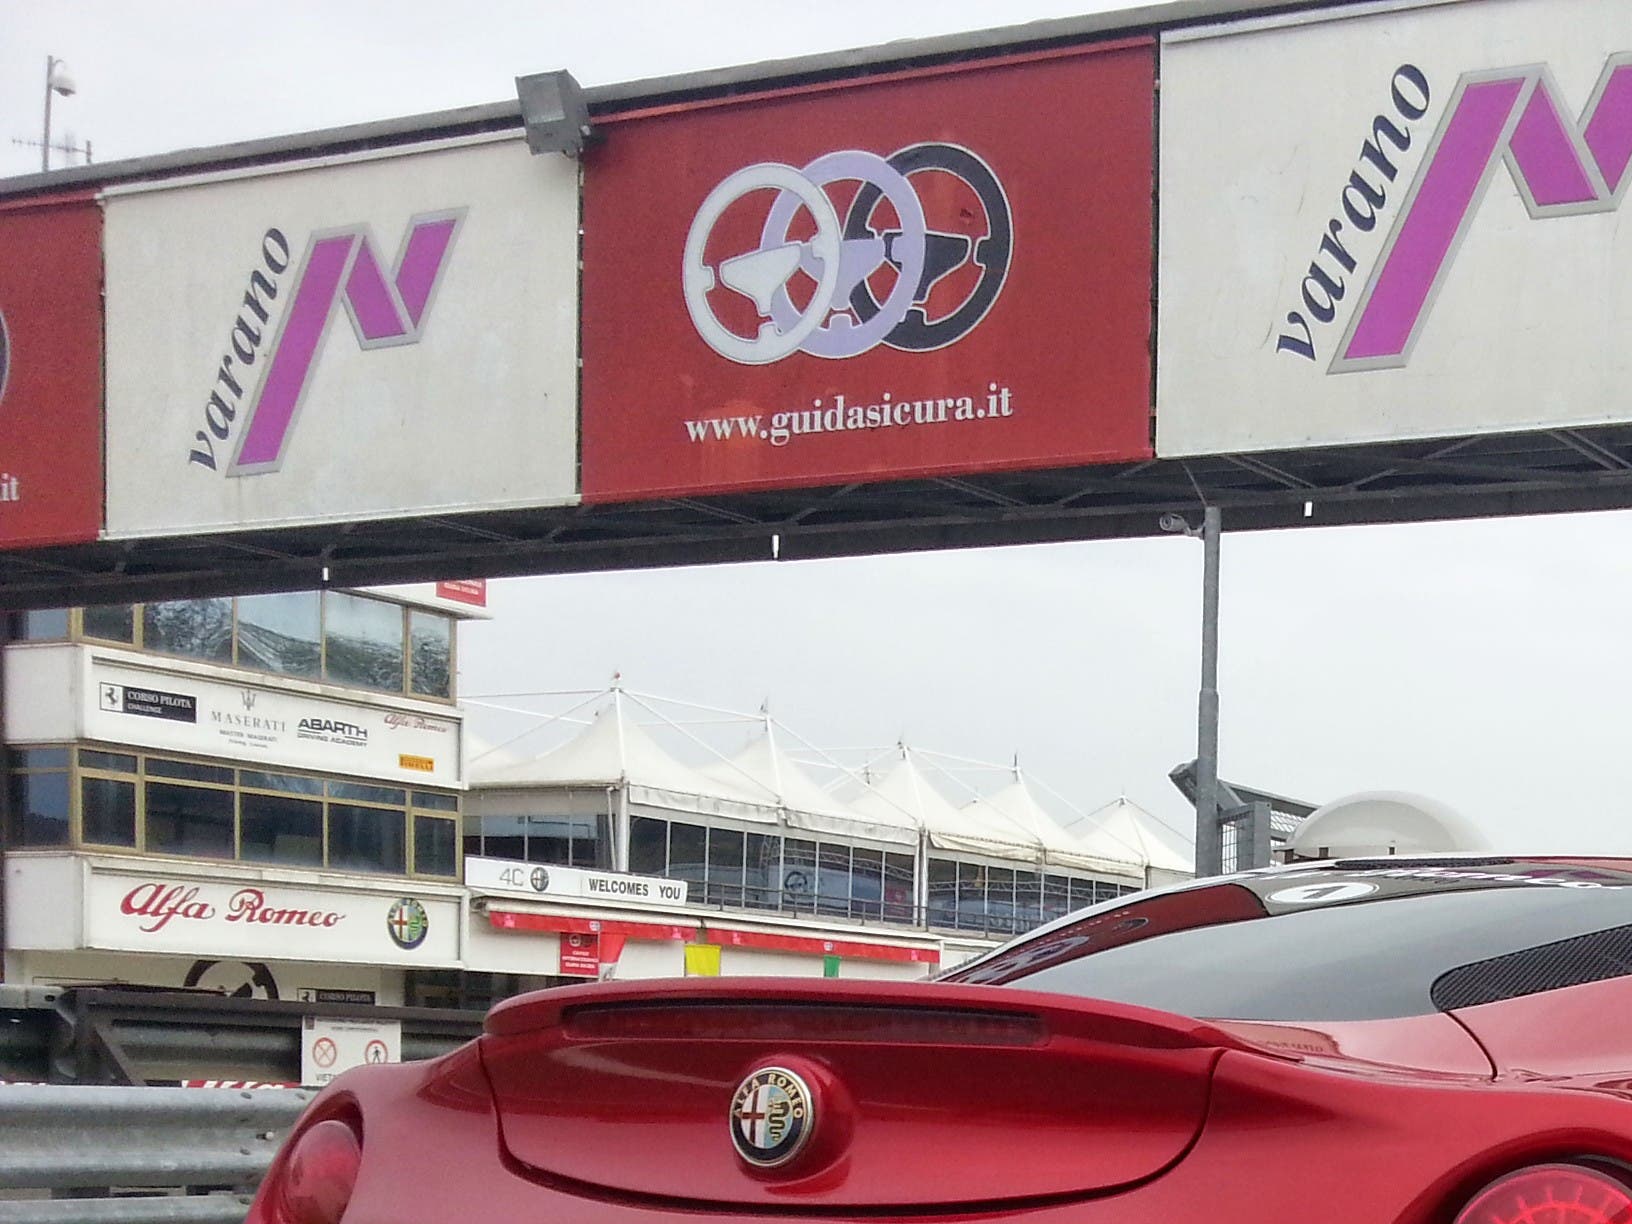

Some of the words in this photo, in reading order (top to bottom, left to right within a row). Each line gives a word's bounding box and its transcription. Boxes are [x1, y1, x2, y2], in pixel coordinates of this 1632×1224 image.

[1276, 63, 1431, 362] varano
[189, 228, 290, 472] varano
[684, 383, 1013, 446] www.guidasicura.it
[160, 695, 193, 709] PILOTA
[212, 711, 286, 732] MASERATI
[298, 718, 368, 738] ABARTH
[384, 713, 409, 730] Alfa
[330, 737, 367, 747] ACADEMY
[499, 867, 524, 887] 4C
[589, 878, 649, 897] WELCOMES
[659, 885, 681, 900] YOU
[120, 883, 215, 933] Alfa
[225, 888, 346, 927] Romeo
[733, 1078, 760, 1118] ALFA
[767, 1073, 804, 1119] ROMEO
